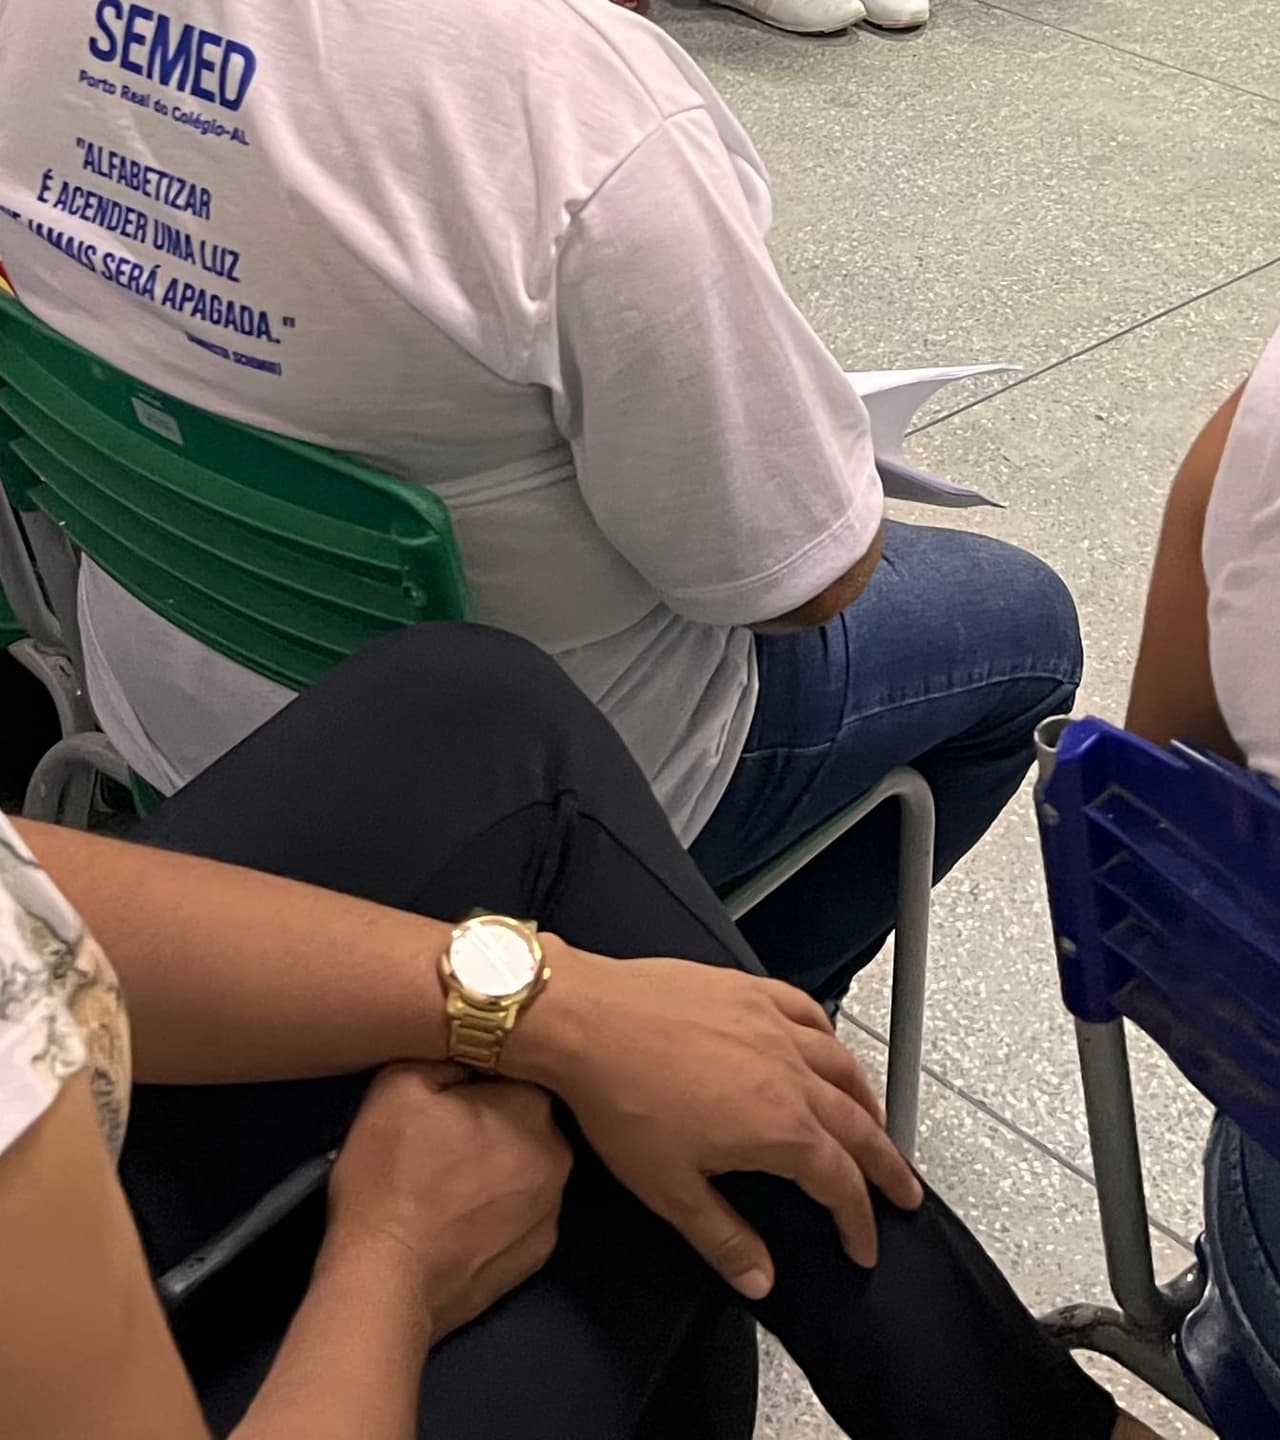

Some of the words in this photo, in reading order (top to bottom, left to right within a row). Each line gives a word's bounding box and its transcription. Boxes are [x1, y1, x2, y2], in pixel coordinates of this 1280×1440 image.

[79, 70, 116, 95] Porto
[120, 85, 150, 107] Real
[75, 137, 213, 221] "ALFABETIZAR
[36, 168, 54, 203] É
[53, 181, 147, 244] ACENDER
[153, 217, 195, 266] UMA
[200, 240, 241, 283] LUZ
[101, 251, 161, 302] SERÁ
